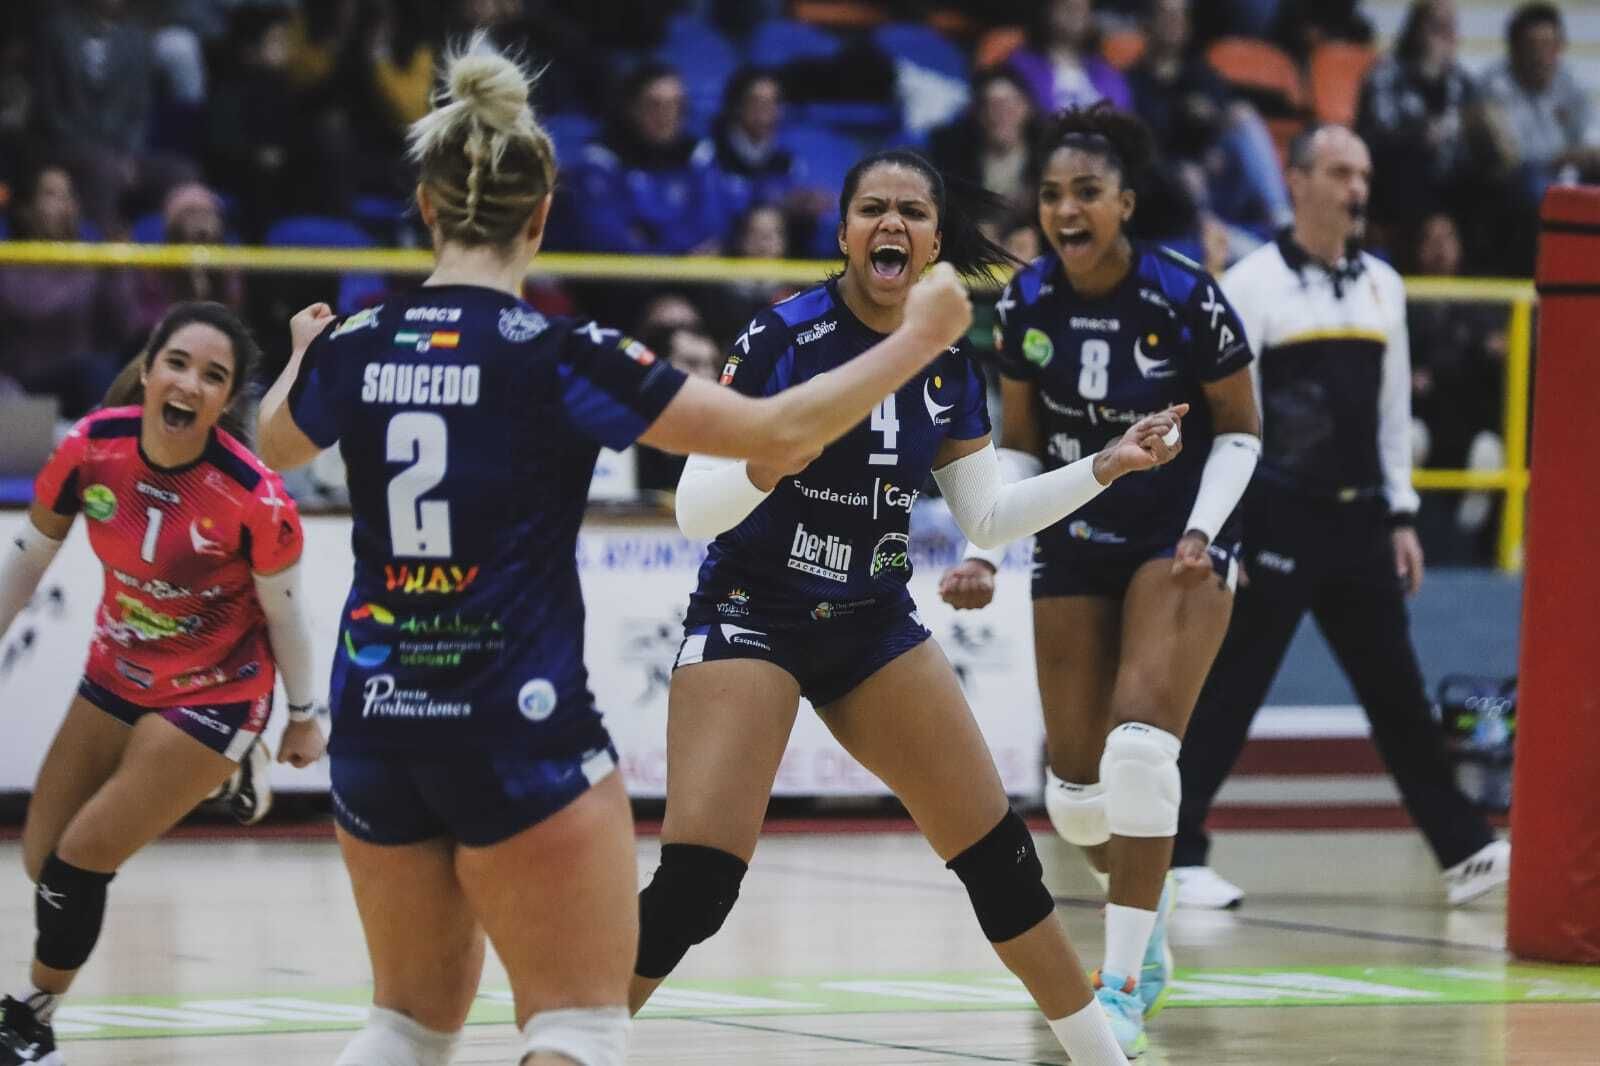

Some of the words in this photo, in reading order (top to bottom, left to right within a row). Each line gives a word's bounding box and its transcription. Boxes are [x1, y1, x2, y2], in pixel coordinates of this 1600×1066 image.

[361, 363, 480, 406] SAUCEDO
[1078, 339, 1110, 400] 8
[870, 392, 900, 449] 4
[386, 412, 452, 557] 2
[885, 486, 920, 513] Caj
[141, 507, 162, 563] 1
[791, 522, 852, 571] berlin
[788, 559, 848, 583] PACKAGING
